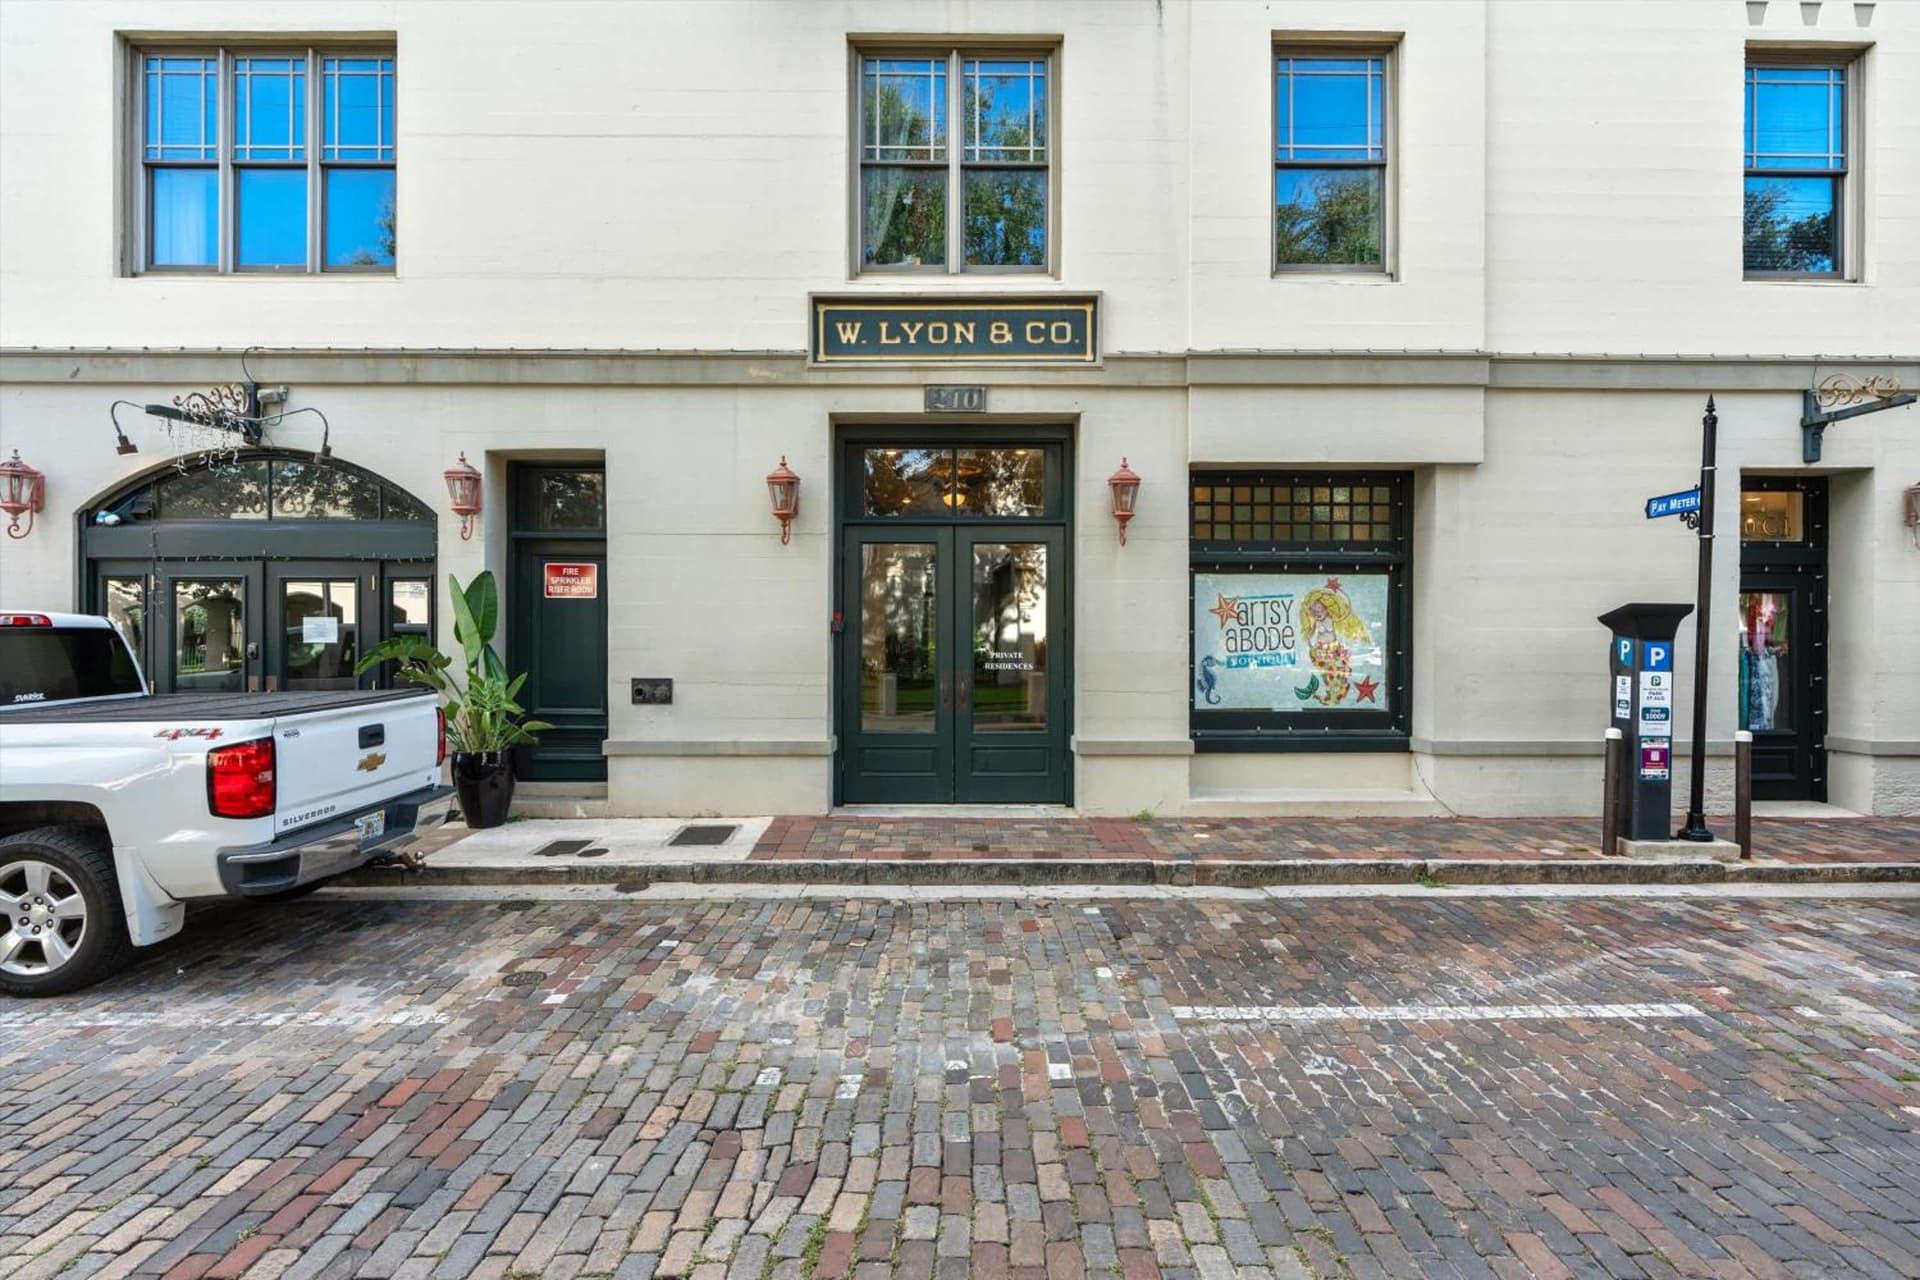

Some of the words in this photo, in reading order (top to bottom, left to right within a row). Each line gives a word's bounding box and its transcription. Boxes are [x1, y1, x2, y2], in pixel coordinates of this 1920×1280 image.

[836, 322, 867, 344] W.
[880, 322, 976, 344] LYON
[989, 322, 1013, 344] &
[1025, 322, 1081, 344] CO.
[1651, 500, 1667, 513] PAY
[1670, 497, 1696, 510] METER
[562, 567, 580, 576] FIRE
[991, 651, 1023, 659] PRIVATE
[1621, 640, 1631, 661] P
[1650, 647, 1665, 666] P
[985, 662, 1034, 670] RESIDENCES
[282, 805, 336, 826] SILVERADO
